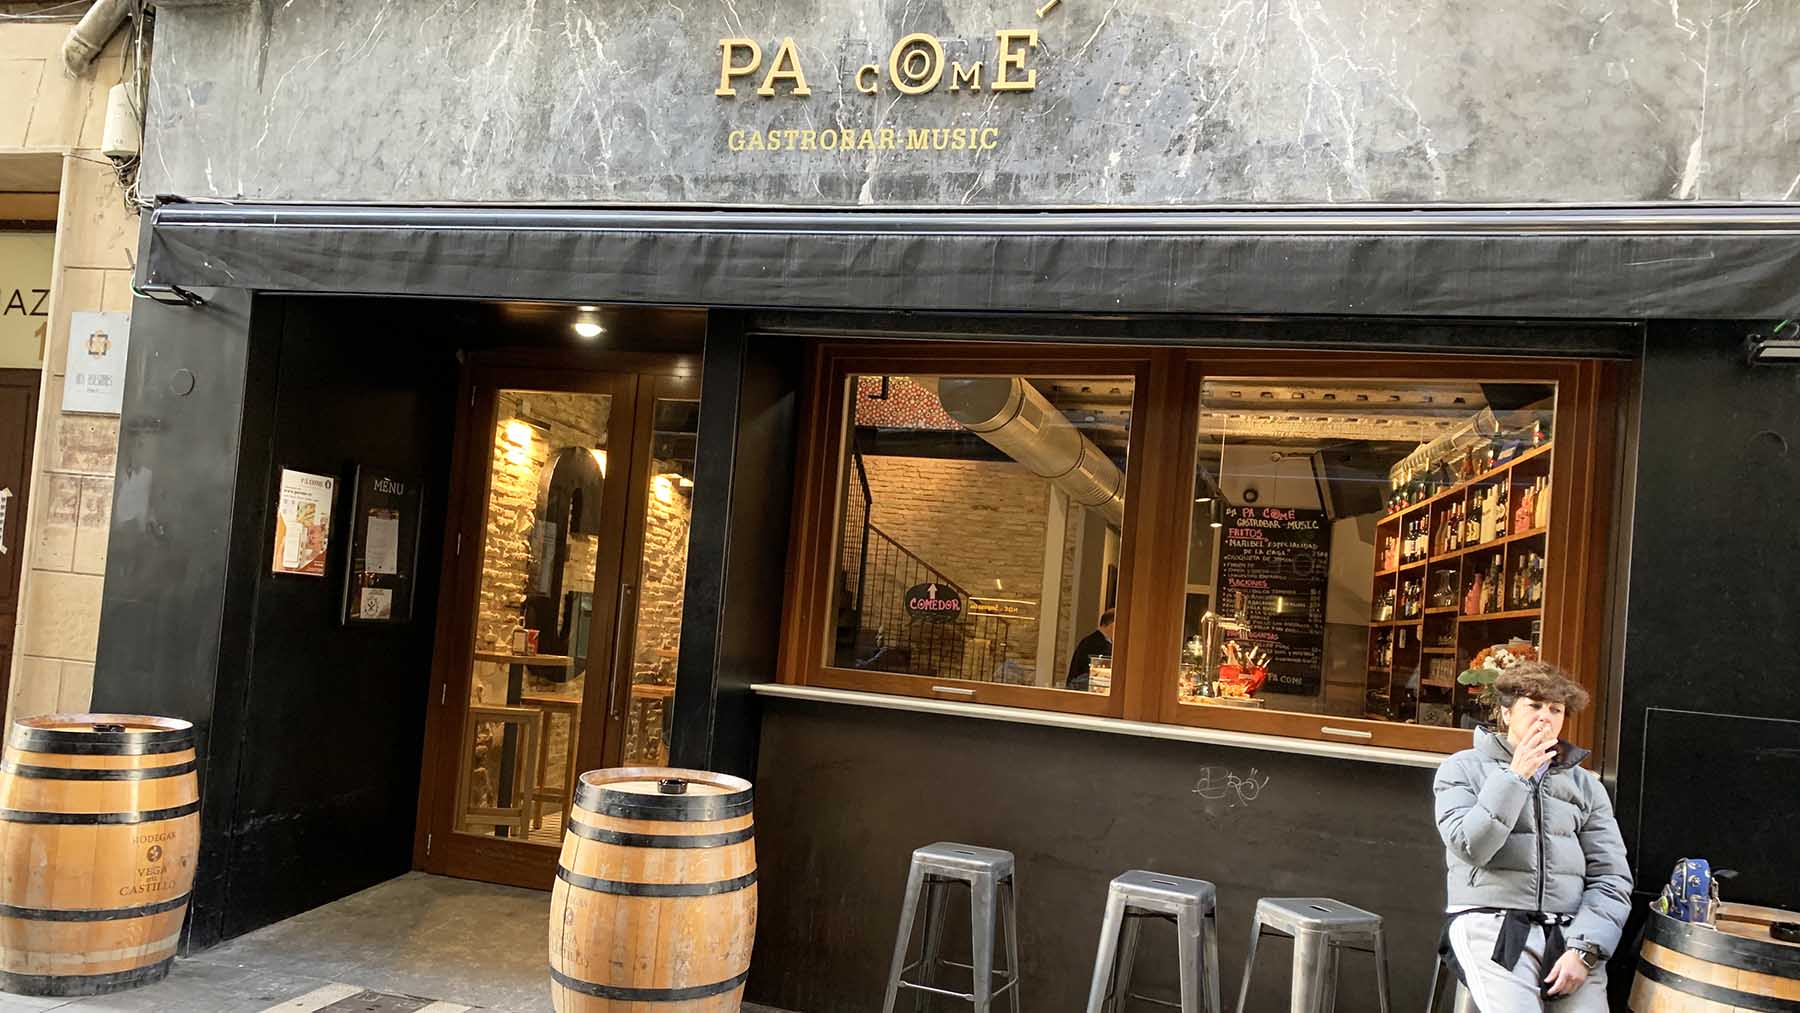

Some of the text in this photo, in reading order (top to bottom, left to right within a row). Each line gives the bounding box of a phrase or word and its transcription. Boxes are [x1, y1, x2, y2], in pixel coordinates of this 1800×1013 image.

[714, 37, 812, 97] PA
[1242, 507, 1255, 518] PA
[1228, 528, 1263, 538] FRITOS
[909, 598, 960, 612] COMEDOR
[138, 866, 167, 876] VEGA
